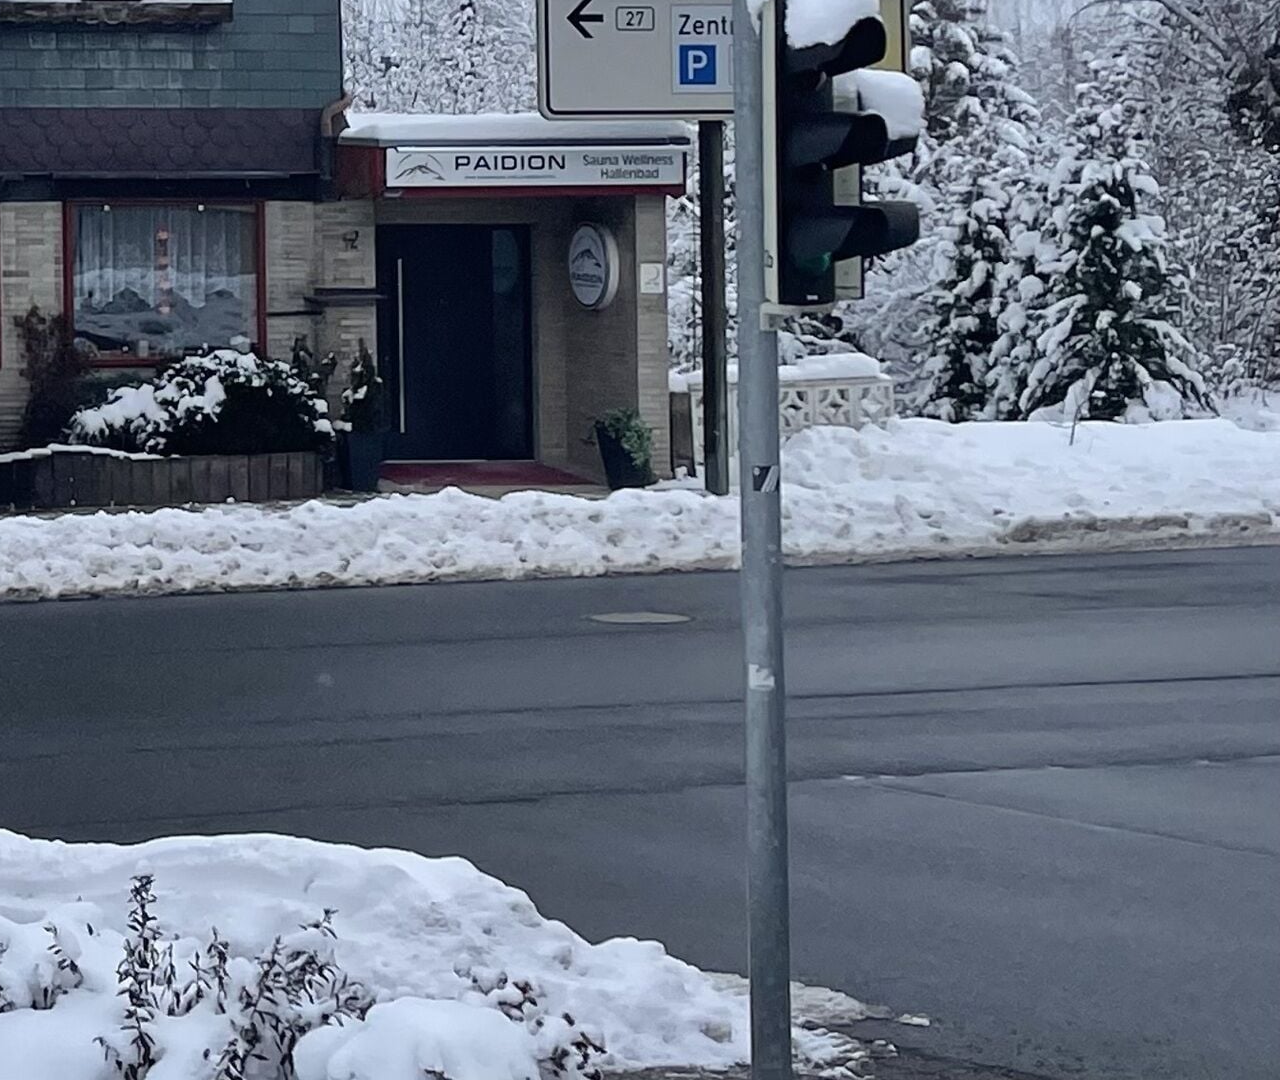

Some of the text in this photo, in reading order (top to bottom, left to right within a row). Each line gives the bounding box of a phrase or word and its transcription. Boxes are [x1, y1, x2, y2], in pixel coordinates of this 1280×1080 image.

[626, 11, 645, 26] 27
[687, 49, 708, 80] P
[454, 154, 566, 171] PAIDION
[582, 154, 674, 166] Sauna Wellness
[600, 168, 660, 180] Hallenbad
